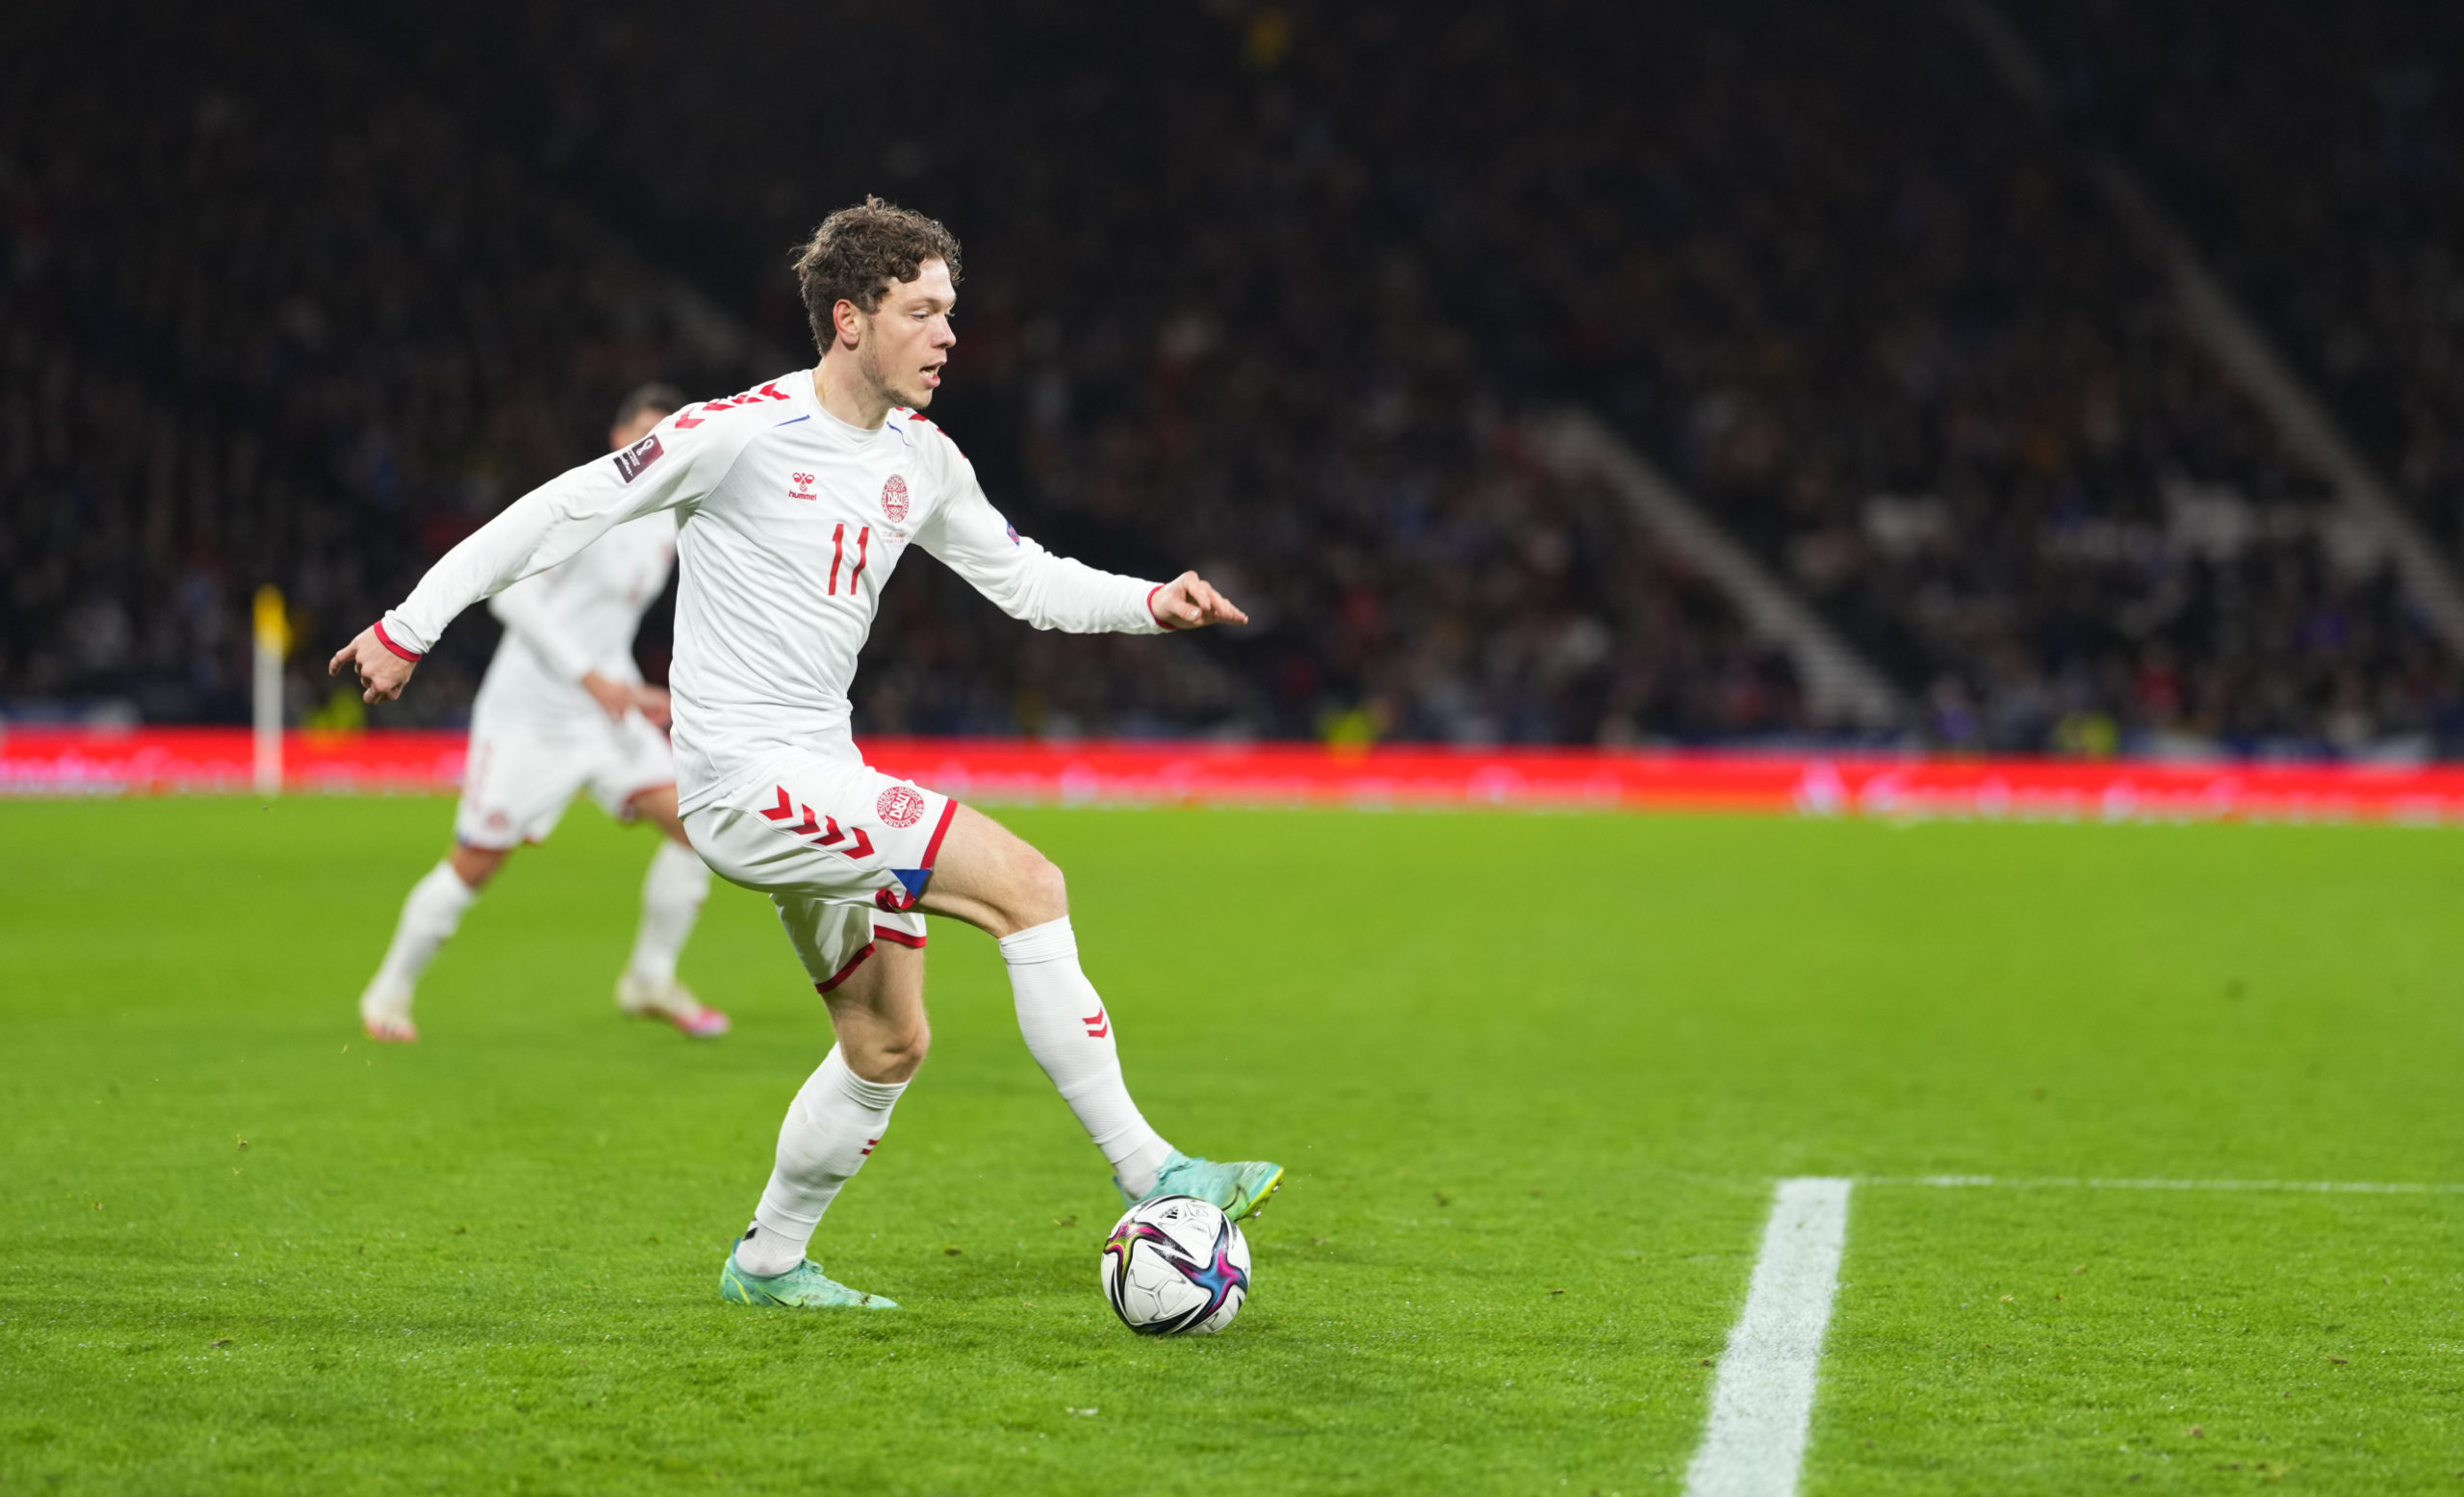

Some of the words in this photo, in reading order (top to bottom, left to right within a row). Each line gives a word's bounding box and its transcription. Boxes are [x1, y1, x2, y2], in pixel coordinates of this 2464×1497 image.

[788, 490, 816, 501] hummel
[886, 491, 903, 504] DBU
[828, 523, 869, 596] 11
[889, 792, 911, 820] DBU
